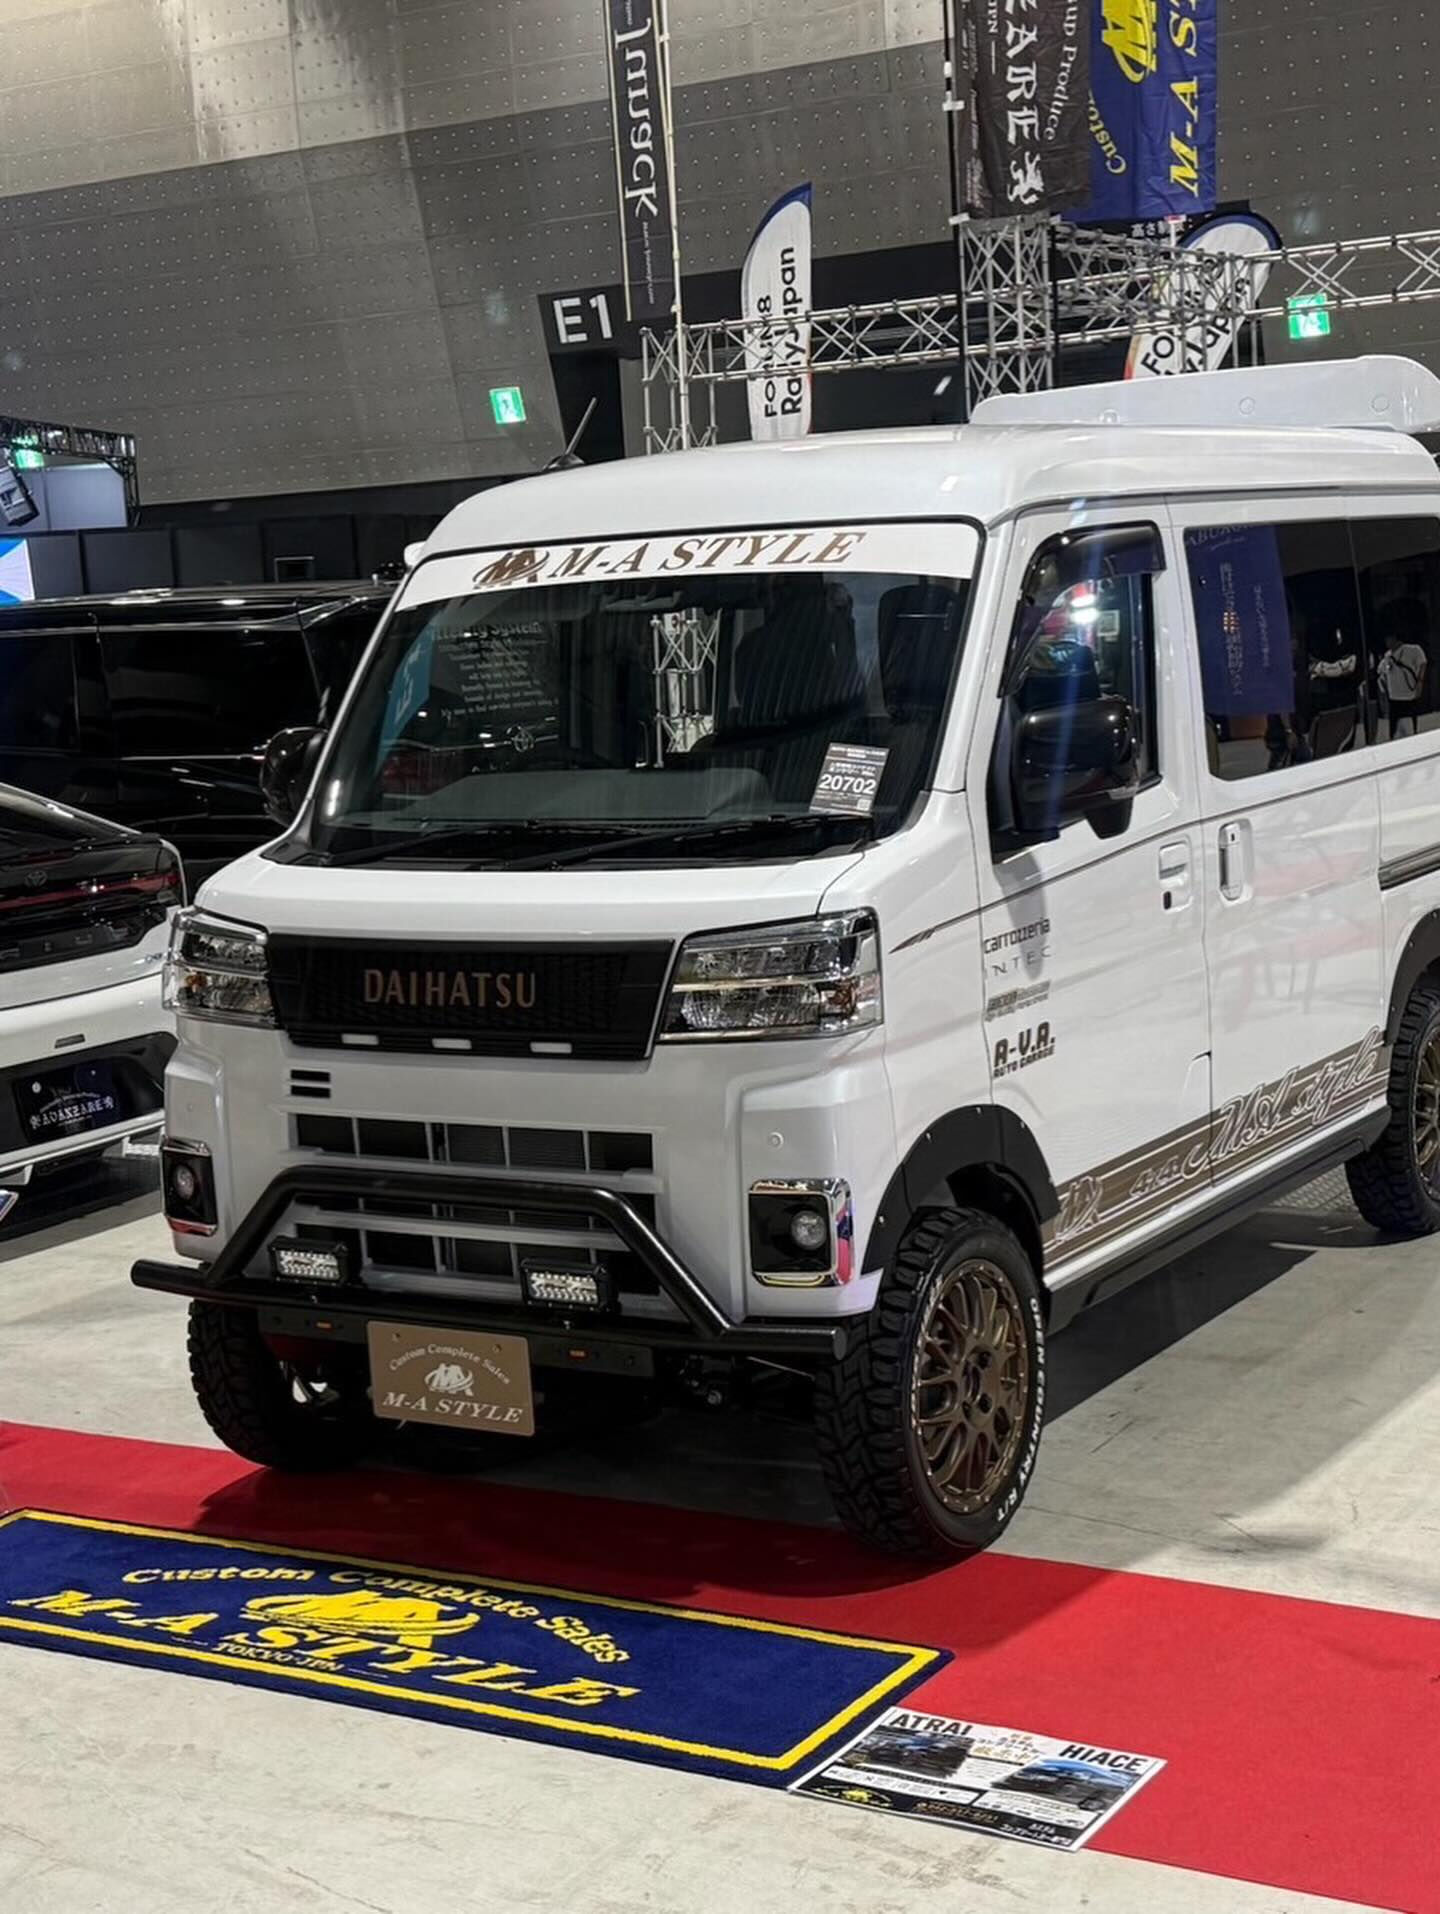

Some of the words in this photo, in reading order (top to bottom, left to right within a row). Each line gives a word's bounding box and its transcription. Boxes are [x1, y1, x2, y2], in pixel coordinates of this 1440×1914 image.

[1044, 46, 1078, 140] Produce
[553, 294, 613, 344] E1
[547, 542, 650, 578] M-A
[657, 532, 867, 571] STYLE
[819, 774, 877, 795] 20702
[363, 969, 536, 1008] DAIHATSU
[1030, 1298, 1045, 1365] OPEN
[389, 1347, 426, 1371] Custom
[428, 1344, 481, 1363] Complete
[483, 1359, 511, 1385] Sales
[382, 1391, 428, 1411] M-A
[435, 1399, 524, 1423] STYLE
[1020, 1370, 1045, 1488] COUNTRY
[122, 1567, 316, 1584] Custom
[329, 1570, 540, 1619] Complete
[534, 1615, 631, 1664] Sales
[8, 1590, 219, 1635] M-A
[220, 1626, 641, 1706] STYLE
[889, 1713, 973, 1735] ATRAI
[1058, 1744, 1148, 1771] HIACE
